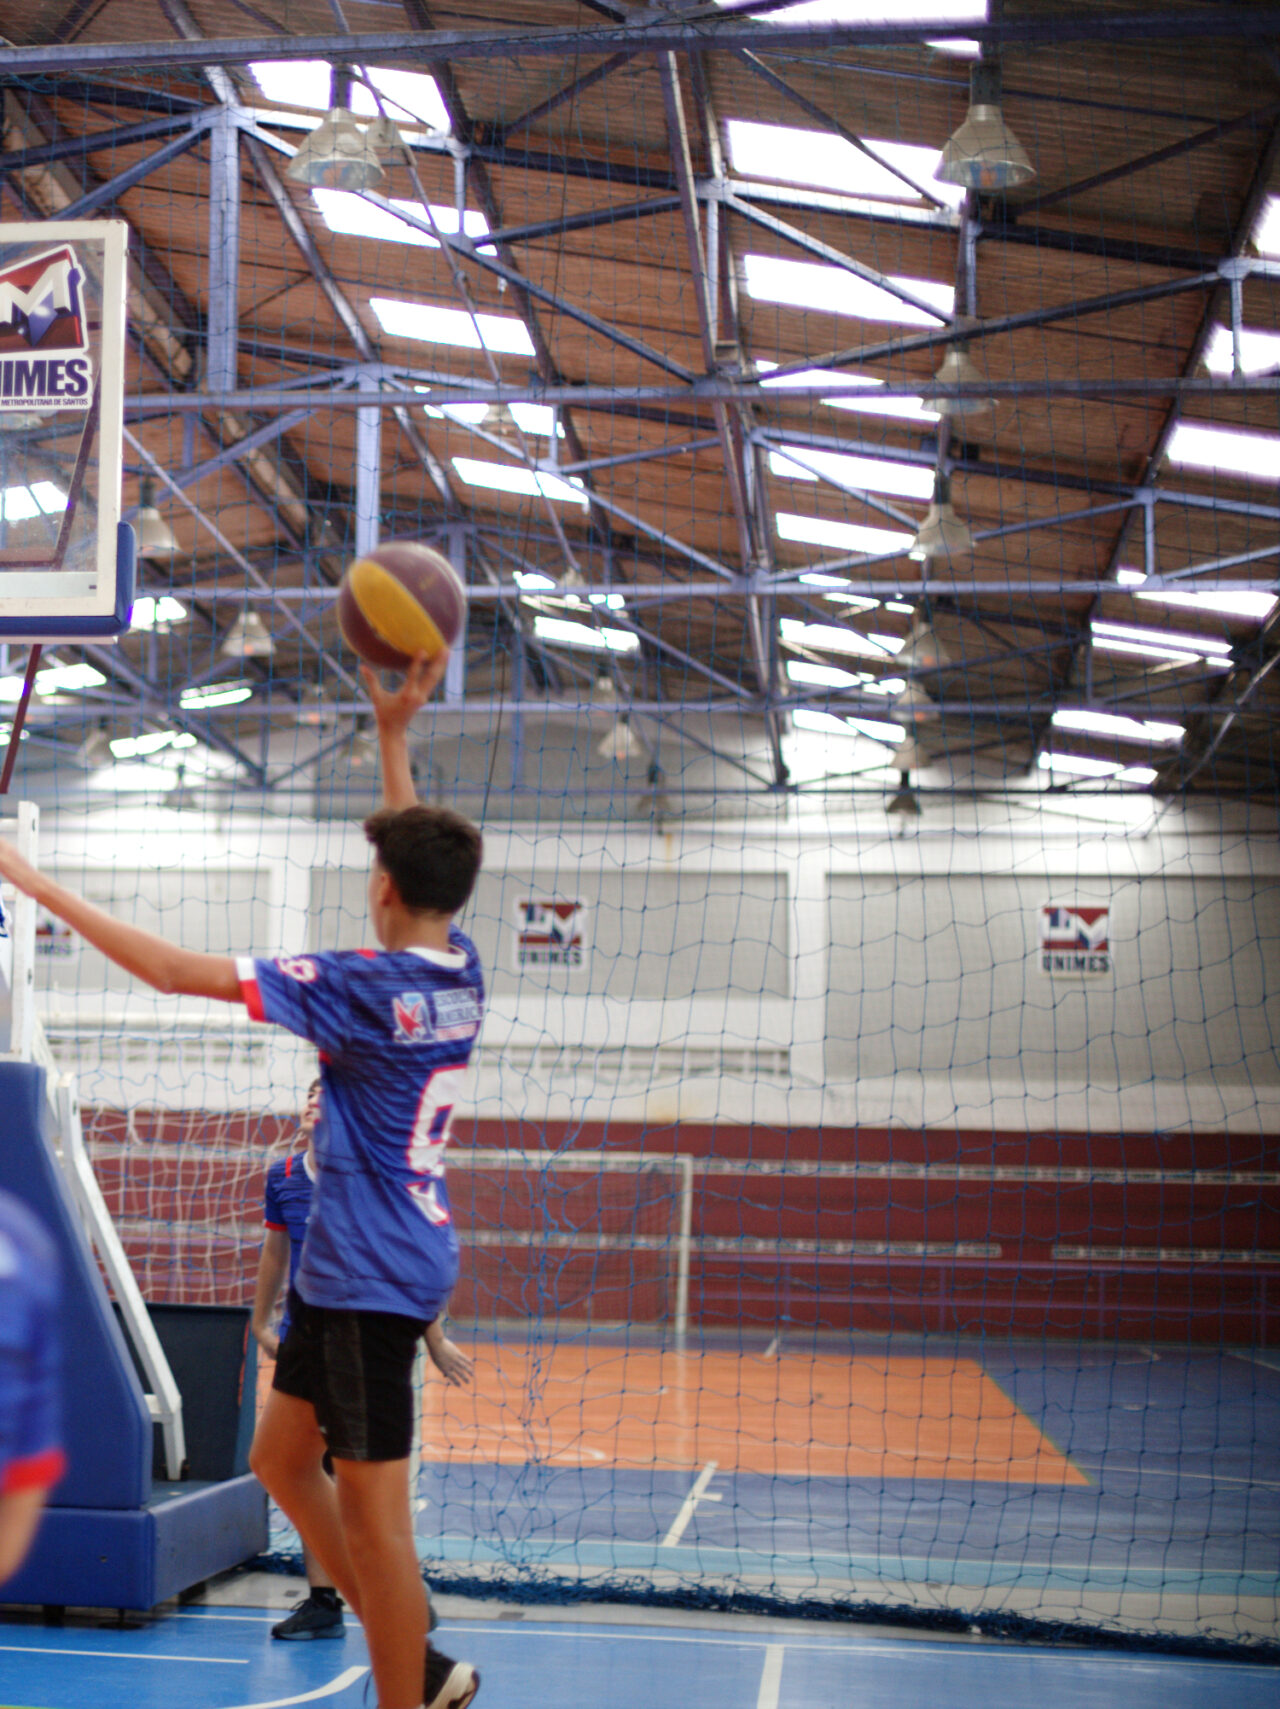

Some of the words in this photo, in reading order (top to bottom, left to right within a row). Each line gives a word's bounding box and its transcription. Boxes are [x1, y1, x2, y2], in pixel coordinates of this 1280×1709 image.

[1, 398, 52, 406] METROPOLITANA
[53, 398, 62, 406] DE
[63, 398, 88, 406] SANTOS
[1042, 955, 1109, 972] UNIMES
